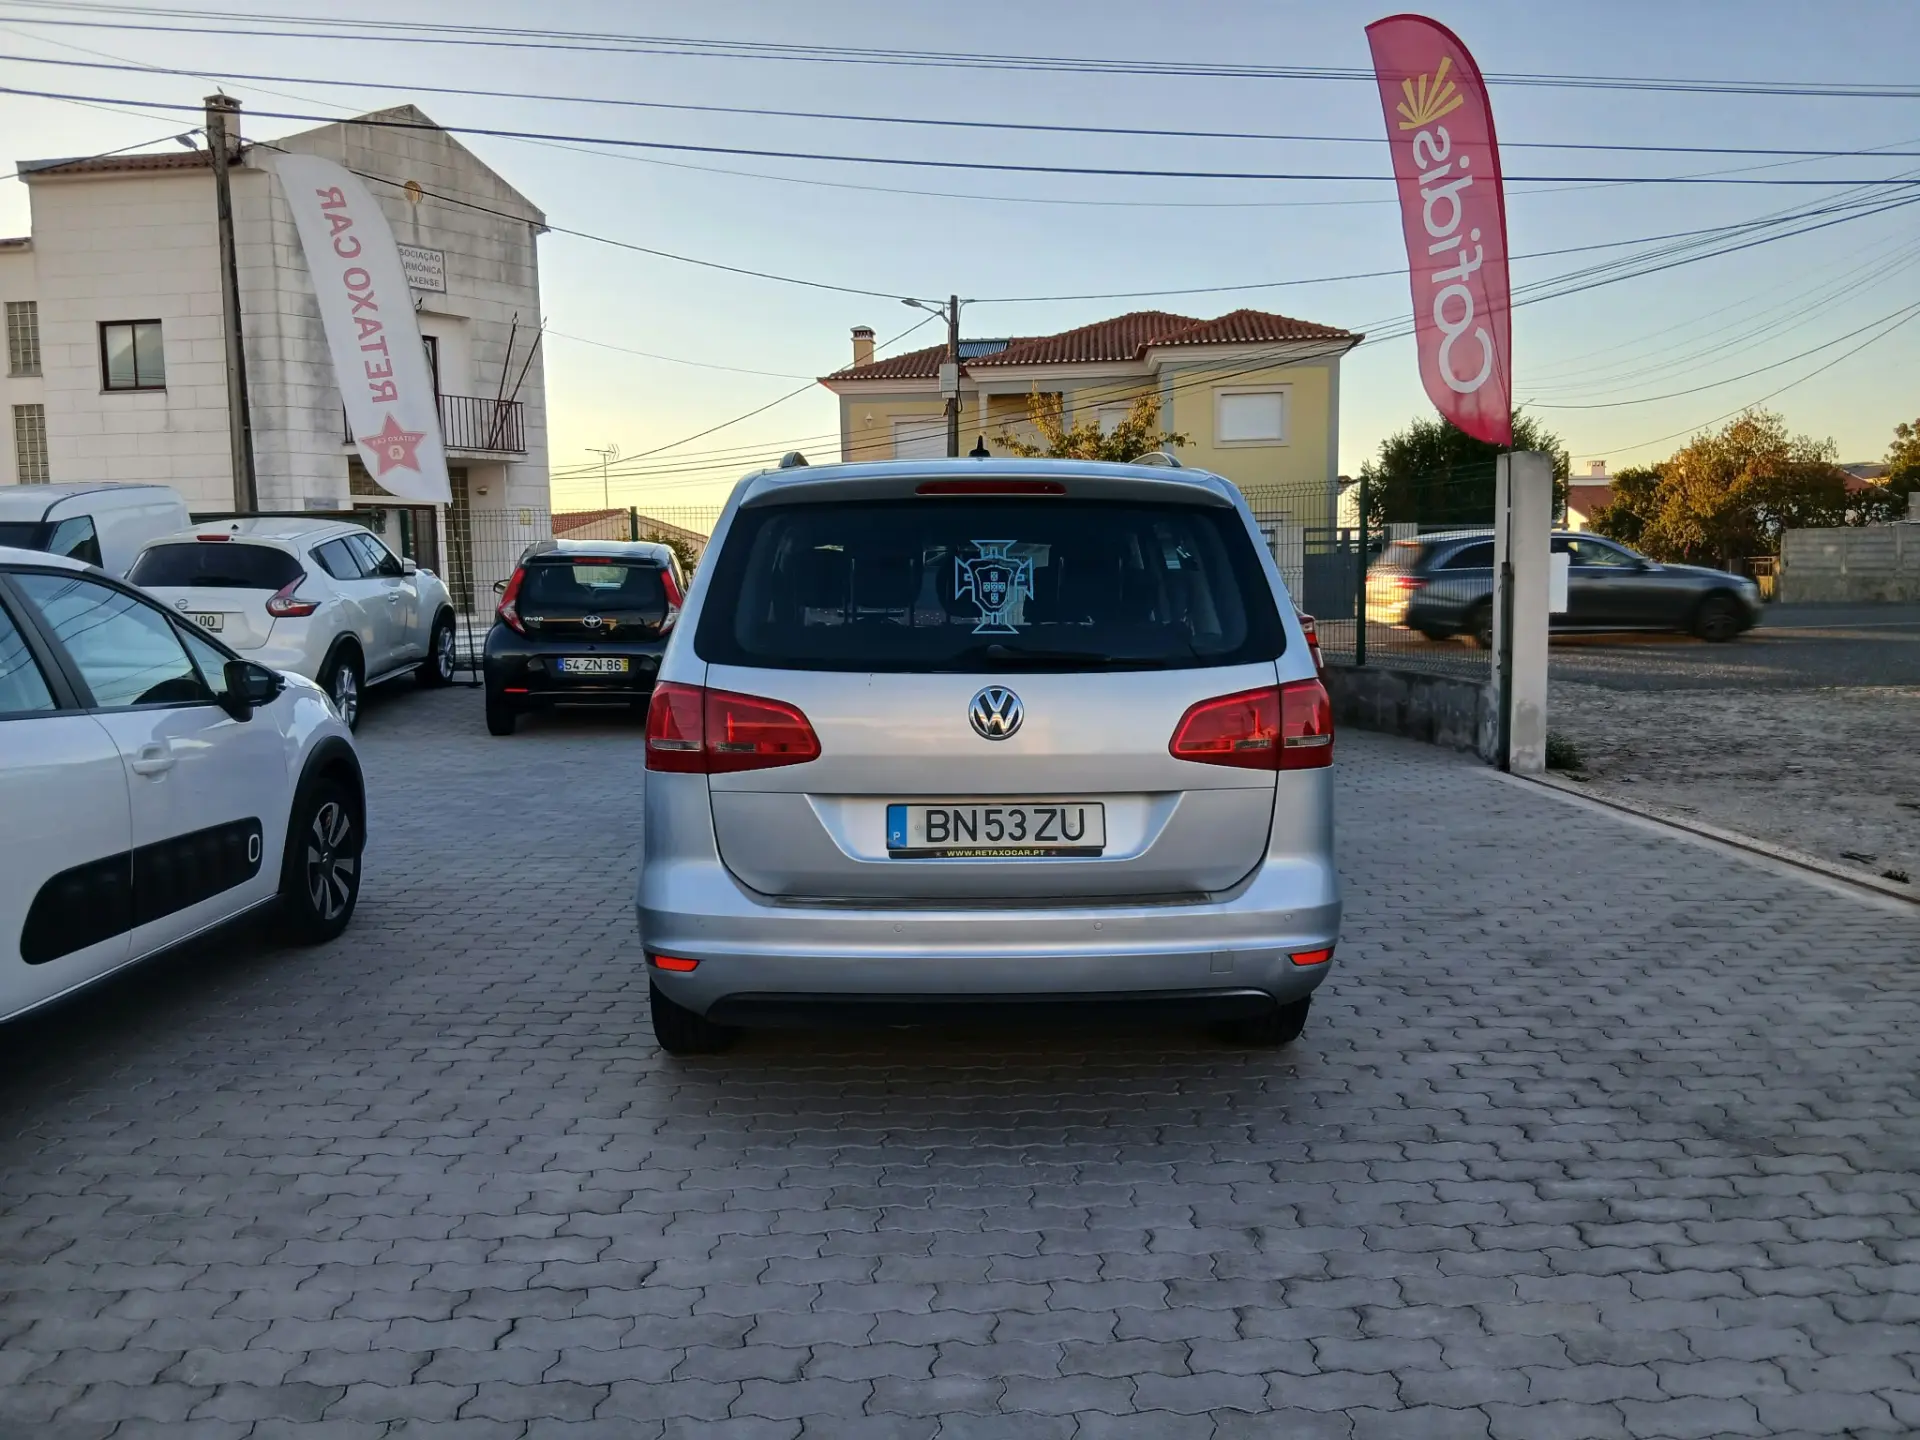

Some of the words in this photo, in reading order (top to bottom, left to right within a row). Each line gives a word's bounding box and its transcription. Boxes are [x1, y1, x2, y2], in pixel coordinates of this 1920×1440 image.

[398, 248, 441, 263] SOCIAÇÃO
[404, 261, 443, 275] RMÓNICA
[407, 275, 441, 287] AXENSE
[893, 831, 901, 841] P
[946, 849, 1046, 857] WWW.RETAXOCAR.PT
